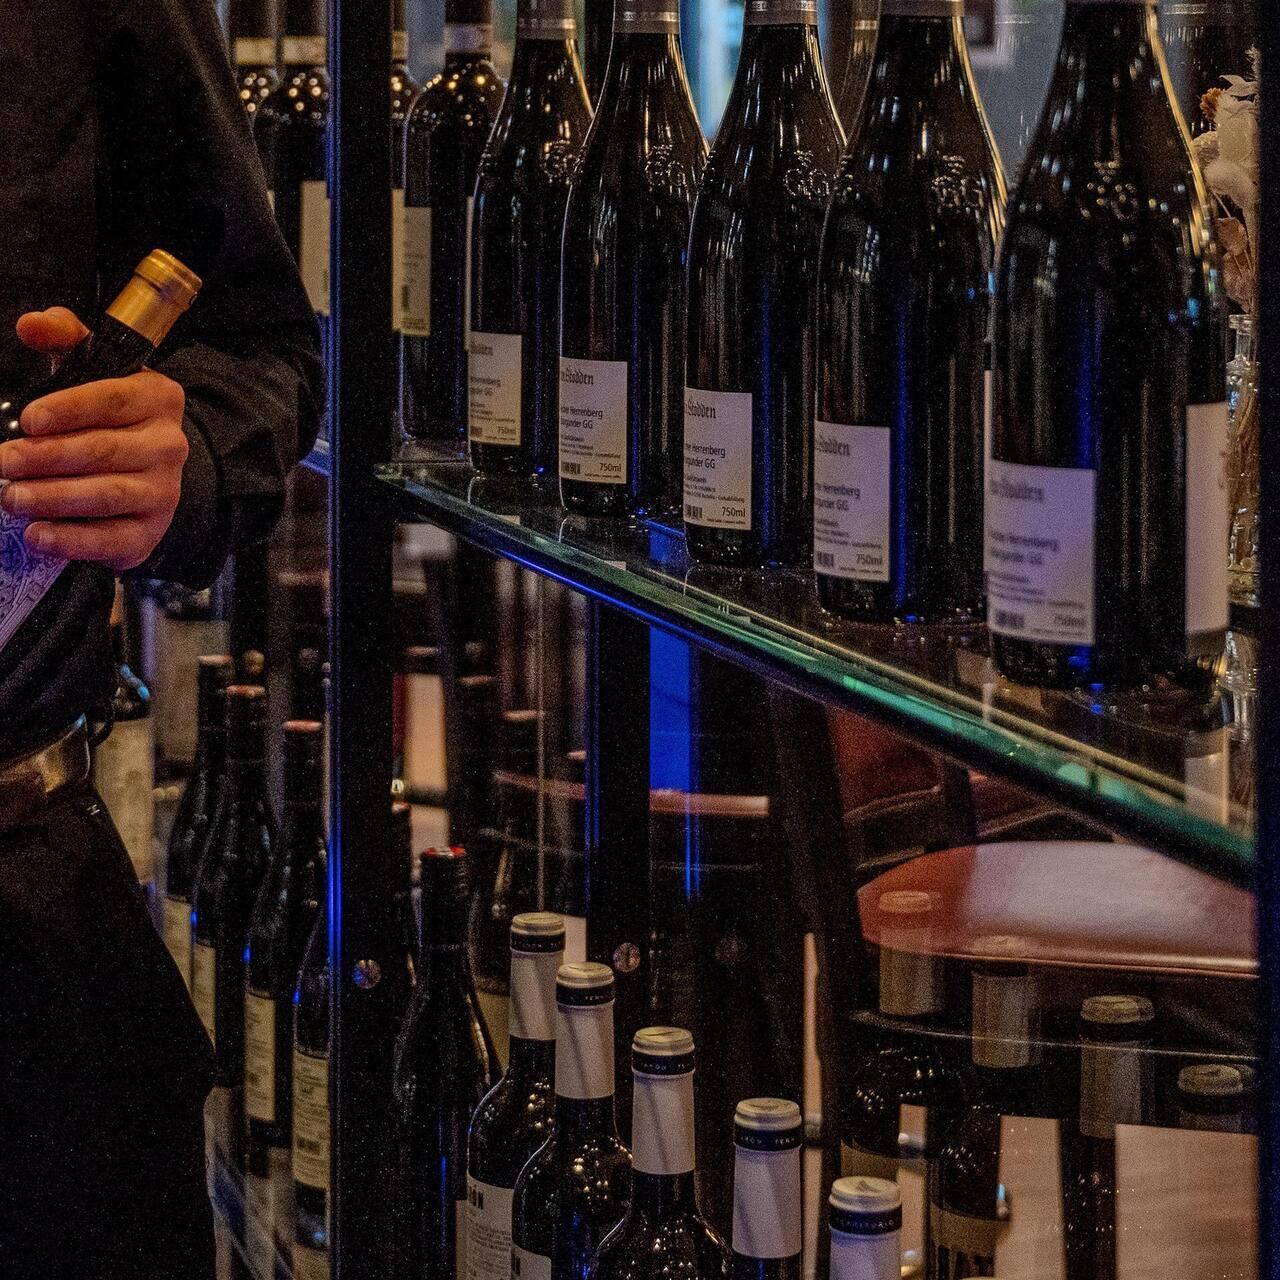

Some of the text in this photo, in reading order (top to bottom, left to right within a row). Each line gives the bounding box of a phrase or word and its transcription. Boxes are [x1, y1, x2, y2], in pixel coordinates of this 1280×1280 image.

[570, 406, 603, 420] Herrenberg
[583, 419, 593, 429] GG
[692, 443, 726, 459] Herrenberg
[599, 463, 622, 472] 750ml
[704, 458, 716, 469] GG
[836, 499, 849, 511] GG
[721, 506, 747, 518] 750ml
[856, 554, 883, 566] 750ml
